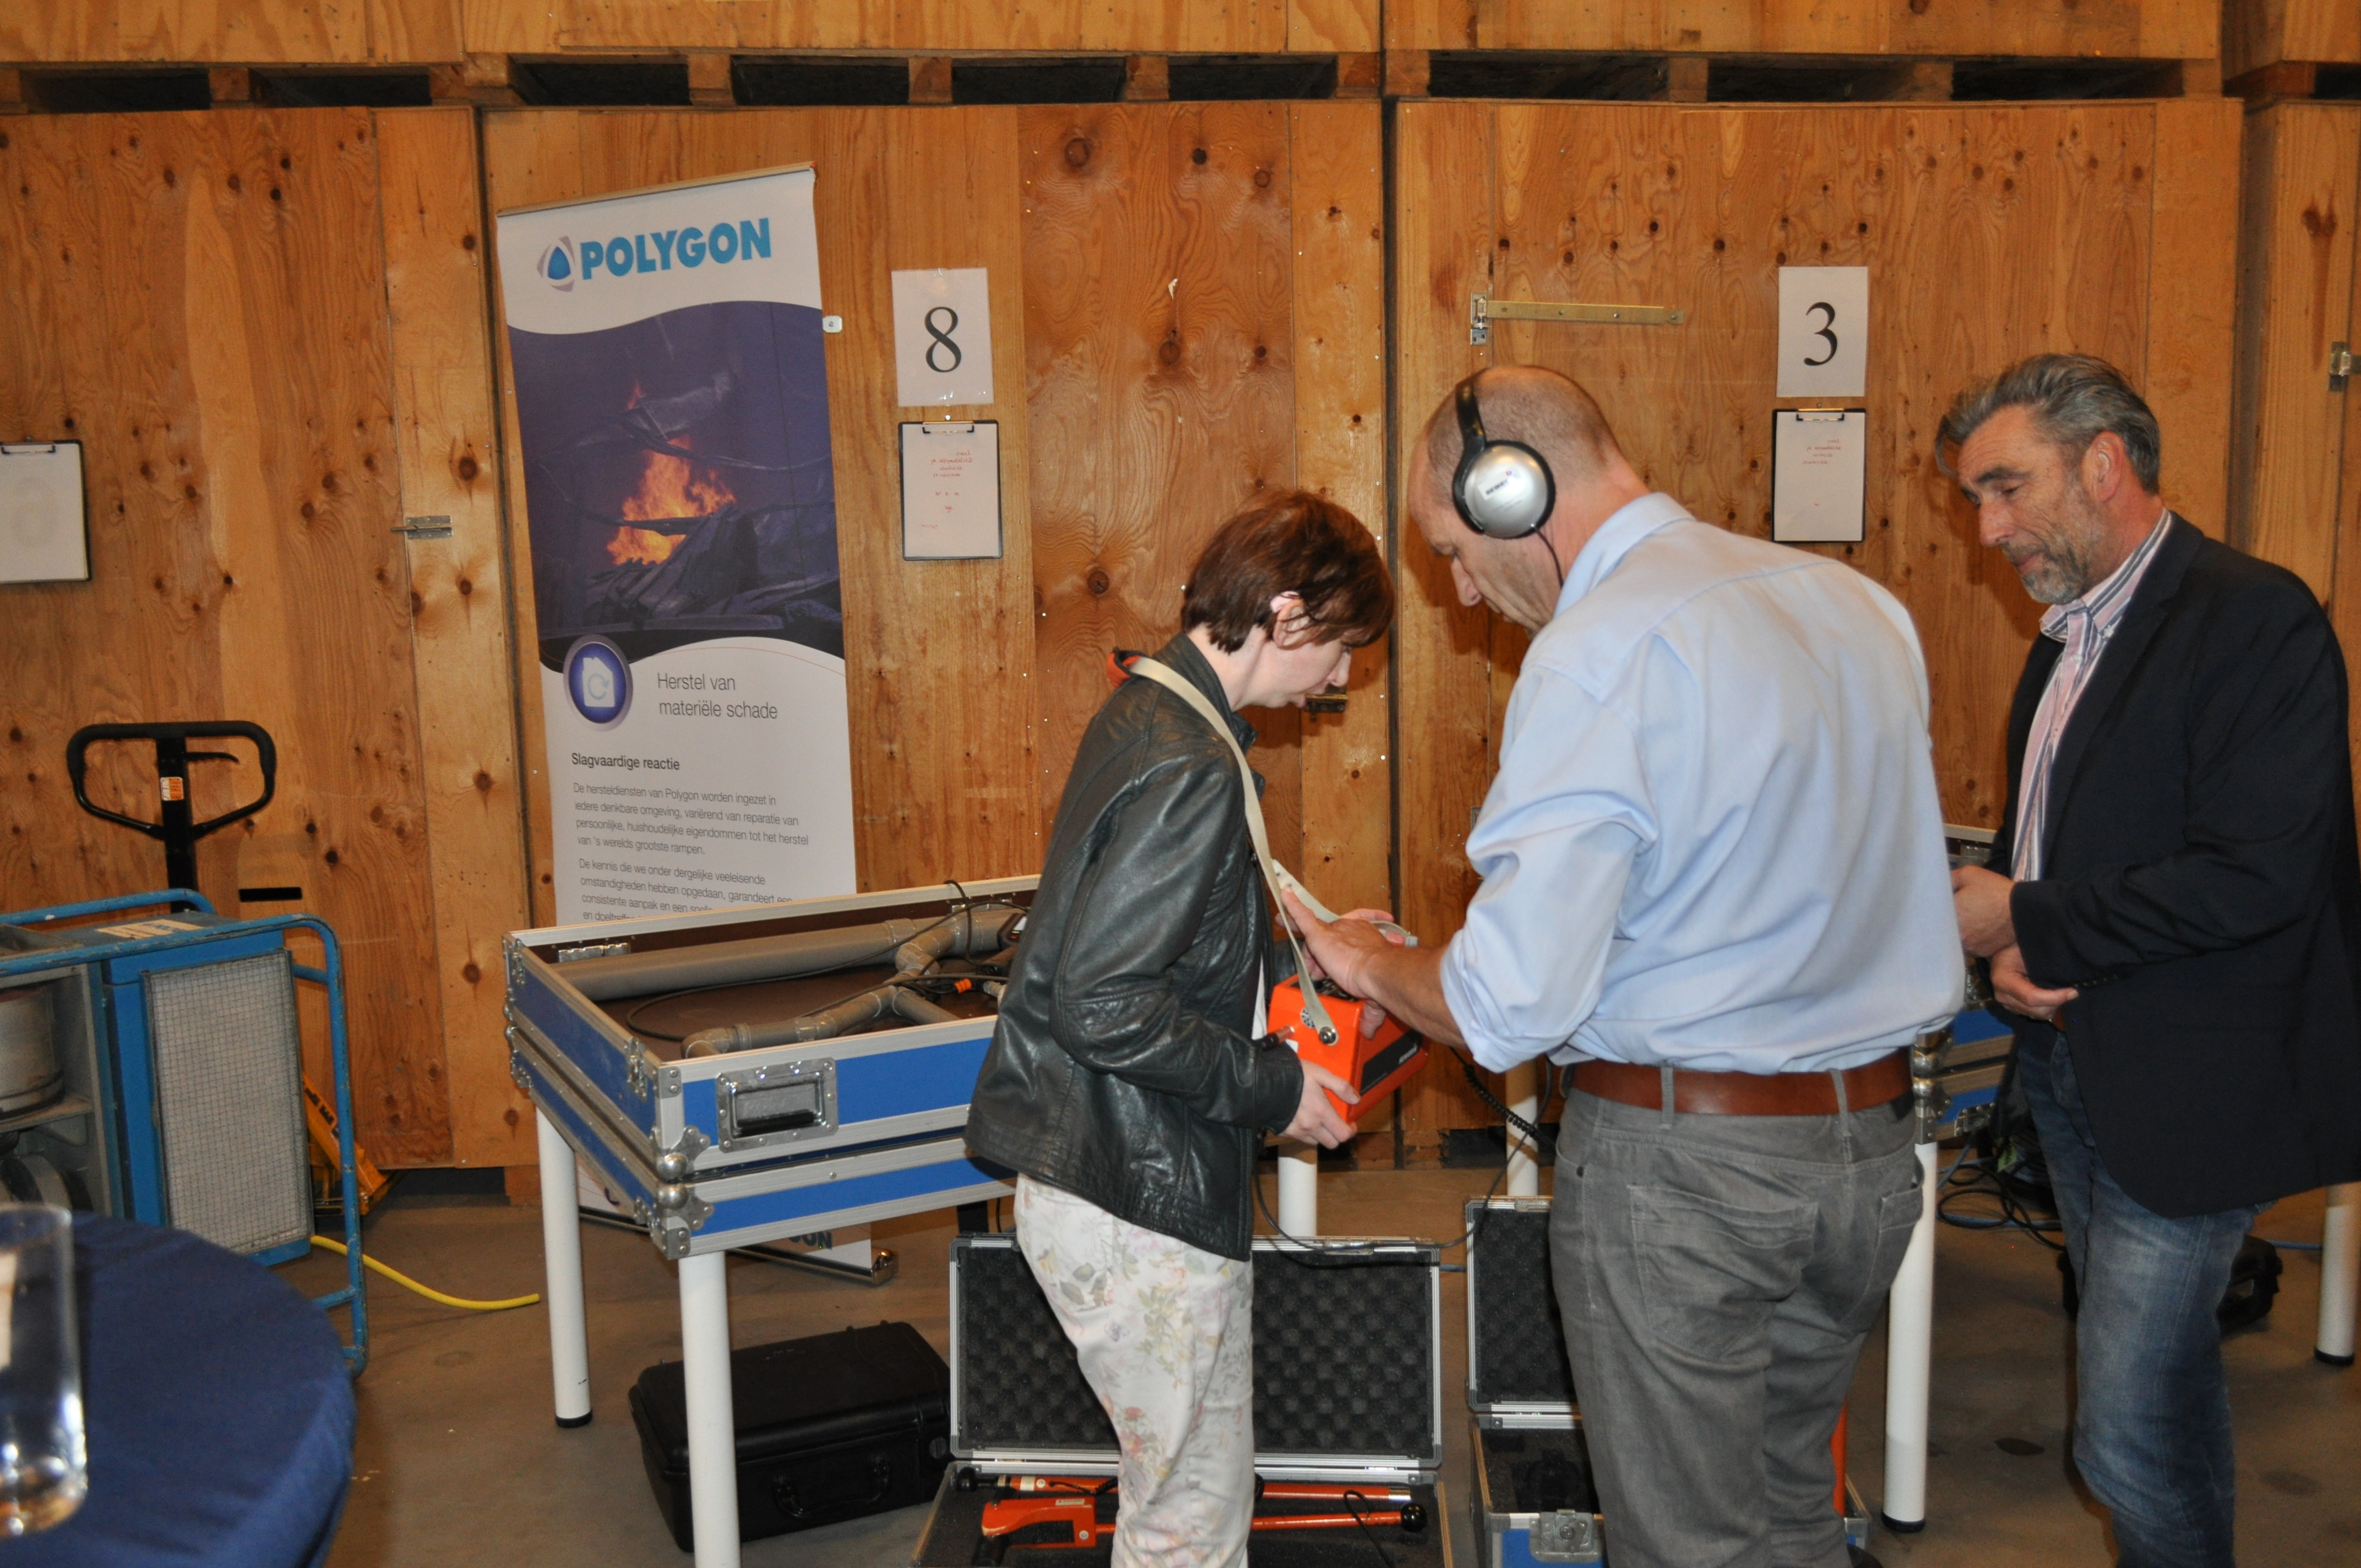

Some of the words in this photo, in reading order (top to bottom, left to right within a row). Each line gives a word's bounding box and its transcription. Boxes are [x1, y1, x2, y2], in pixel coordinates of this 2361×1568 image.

[580, 217, 771, 280] POLYGON
[924, 306, 962, 373] 8
[1803, 301, 1838, 366] 3
[657, 672, 705, 690] Herstel
[710, 677, 736, 690] van
[659, 700, 721, 716] materiële
[726, 701, 777, 719] schade
[572, 753, 640, 771] Slagvaardige
[643, 758, 680, 770] reactie
[573, 782, 584, 793] De
[586, 784, 646, 797] hersteldiensten
[648, 790, 663, 798] van
[665, 788, 699, 802] Polygon
[701, 792, 733, 803] worden
[736, 793, 766, 806] ingezet
[769, 795, 776, 805] in
[575, 801, 599, 812] iedere
[601, 802, 638, 814] denkbare
[640, 805, 682, 819] omgeving,
[684, 809, 723, 820] variërend
[725, 813, 741, 821] van
[743, 813, 780, 825] reparatie
[782, 816, 798, 825] van
[576, 819, 625, 832] persoonlijke,
[627, 821, 684, 836] huishoudelijke
[686, 825, 746, 840] eigendommen
[749, 831, 761, 841] tot
[763, 831, 776, 842] het
[779, 832, 809, 845] herstel
[578, 836, 591, 845] van
[602, 838, 633, 848] werelds
[635, 840, 668, 852] grootste
[671, 844, 705, 856] rampen.
[579, 858, 590, 869] De
[592, 859, 618, 871] kennis
[619, 862, 632, 873] die
[634, 865, 646, 874] we
[648, 865, 672, 876] onder
[674, 867, 713, 881] dergelijke
[715, 872, 765, 885] veeleisende
[580, 877, 646, 891] omstandigheden
[648, 881, 679, 894] hebben
[681, 887, 726, 900] opgedaan,
[728, 891, 775, 903] garandeert
[581, 894, 627, 906] consistente
[628, 900, 658, 910] aanpak
[660, 903, 670, 911] en
[672, 904, 688, 912] een
[583, 911, 592, 919] en
